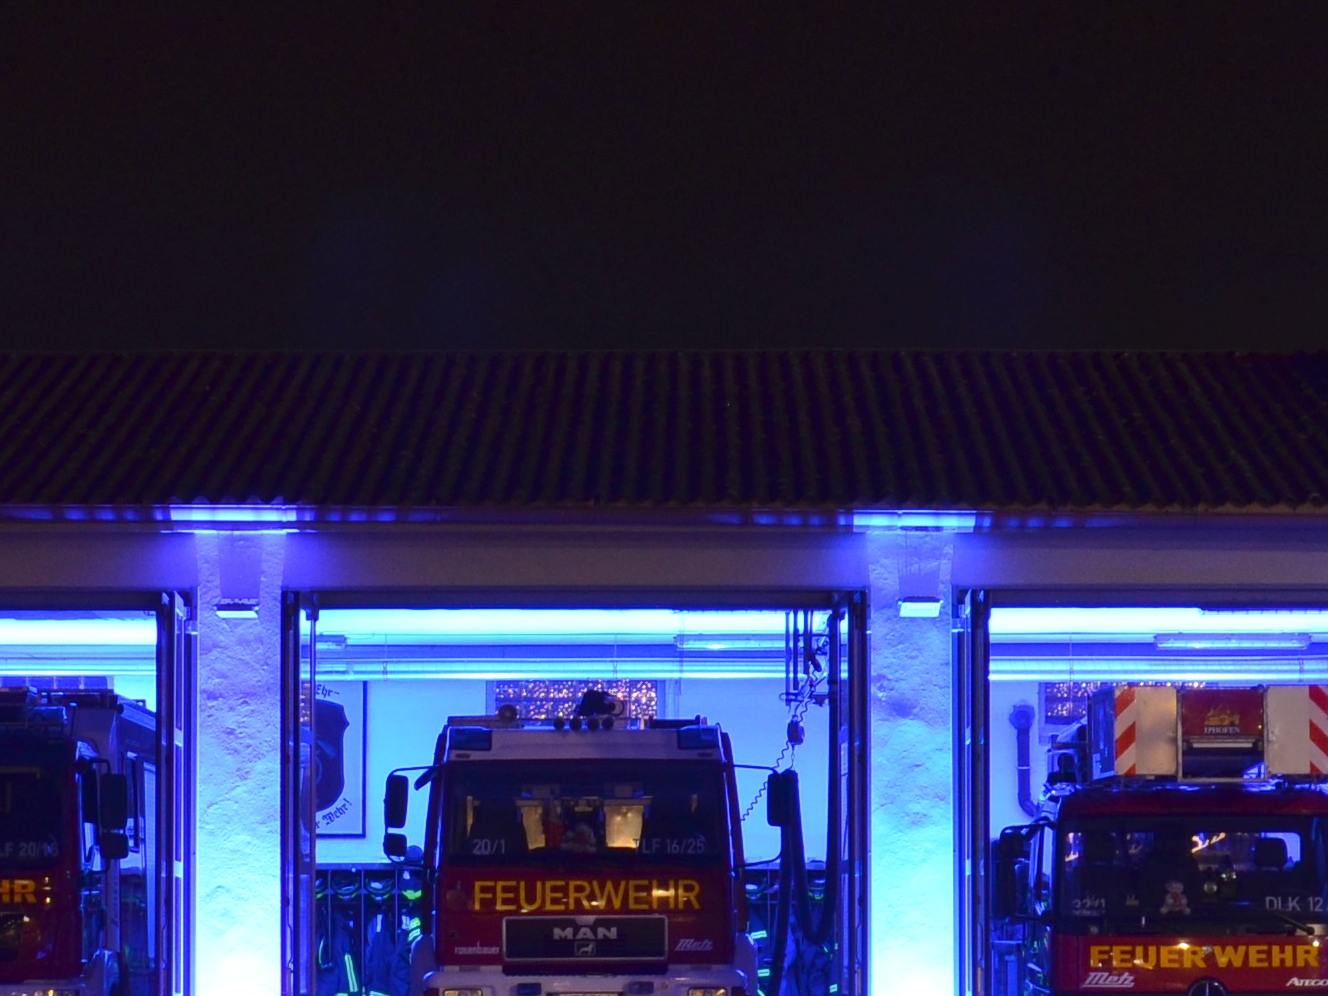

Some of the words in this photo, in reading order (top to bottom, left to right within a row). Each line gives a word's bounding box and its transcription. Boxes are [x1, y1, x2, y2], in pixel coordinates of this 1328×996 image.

[1204, 726, 1240, 734] IPHOFEN
[472, 839, 505, 855] 20/1
[666, 838, 705, 854] 16/25
[473, 879, 702, 911] FEUERWEHR
[1265, 896, 1301, 912] DLK
[552, 927, 618, 940] MAN
[1080, 971, 1135, 988] Metz
